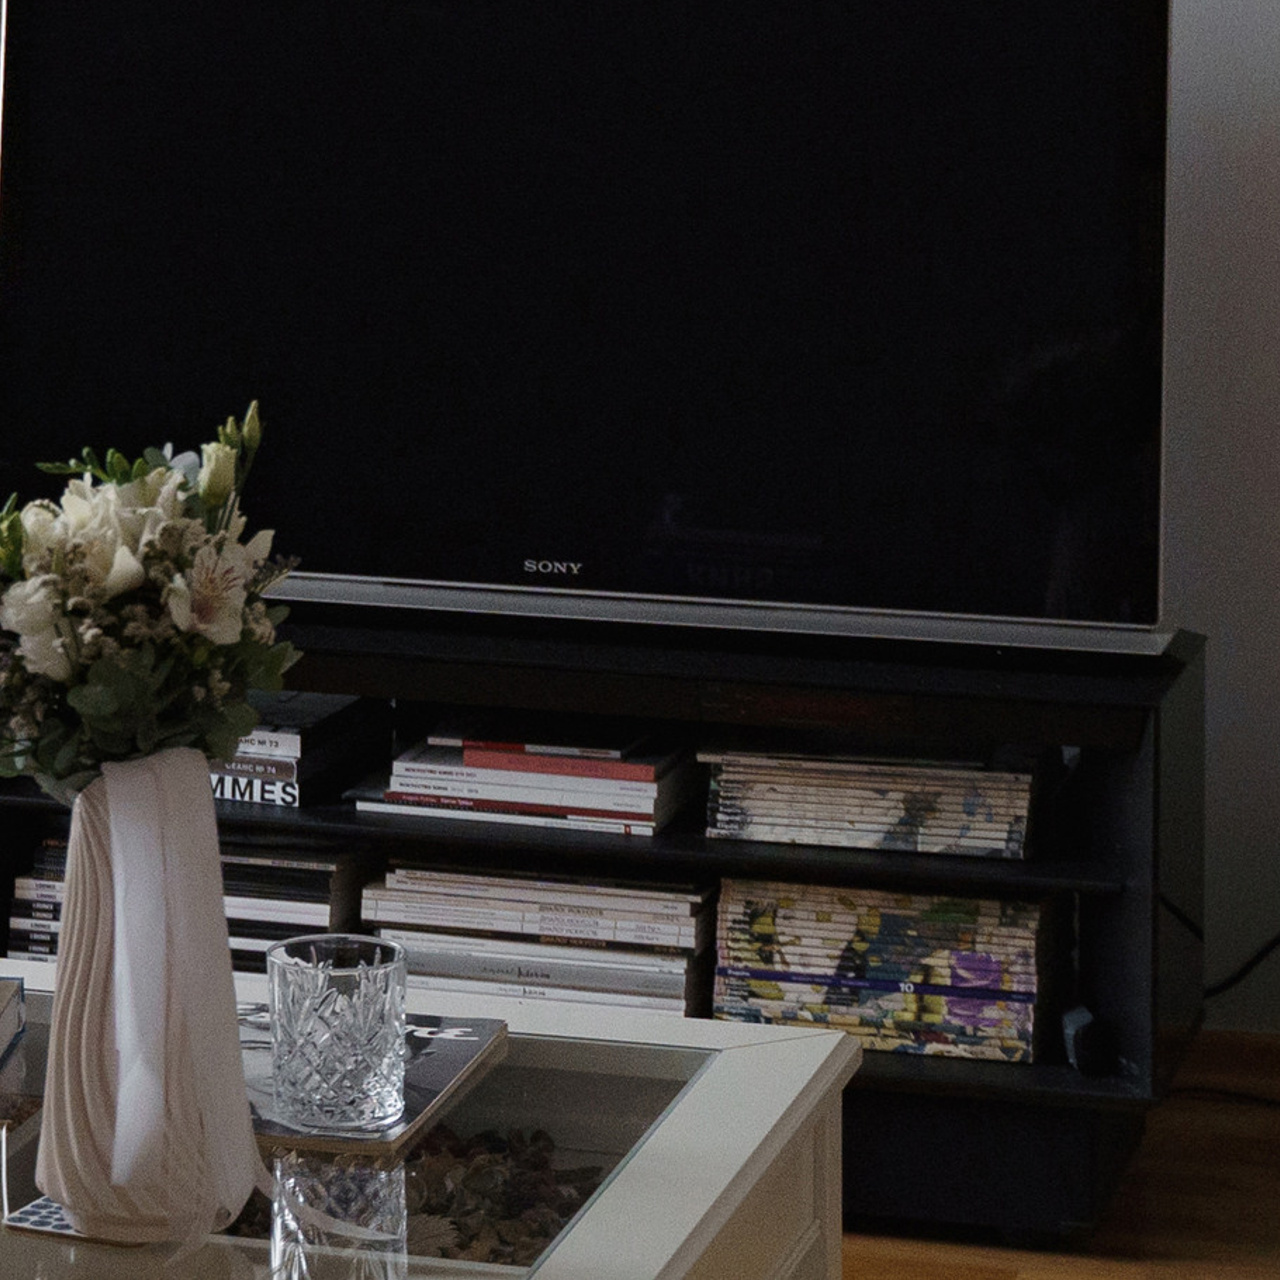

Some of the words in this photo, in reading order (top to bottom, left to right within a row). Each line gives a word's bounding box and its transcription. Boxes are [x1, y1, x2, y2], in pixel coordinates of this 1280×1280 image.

[523, 558, 583, 575] SONY
[211, 776, 297, 817] MMES
[899, 982, 914, 994] 10
